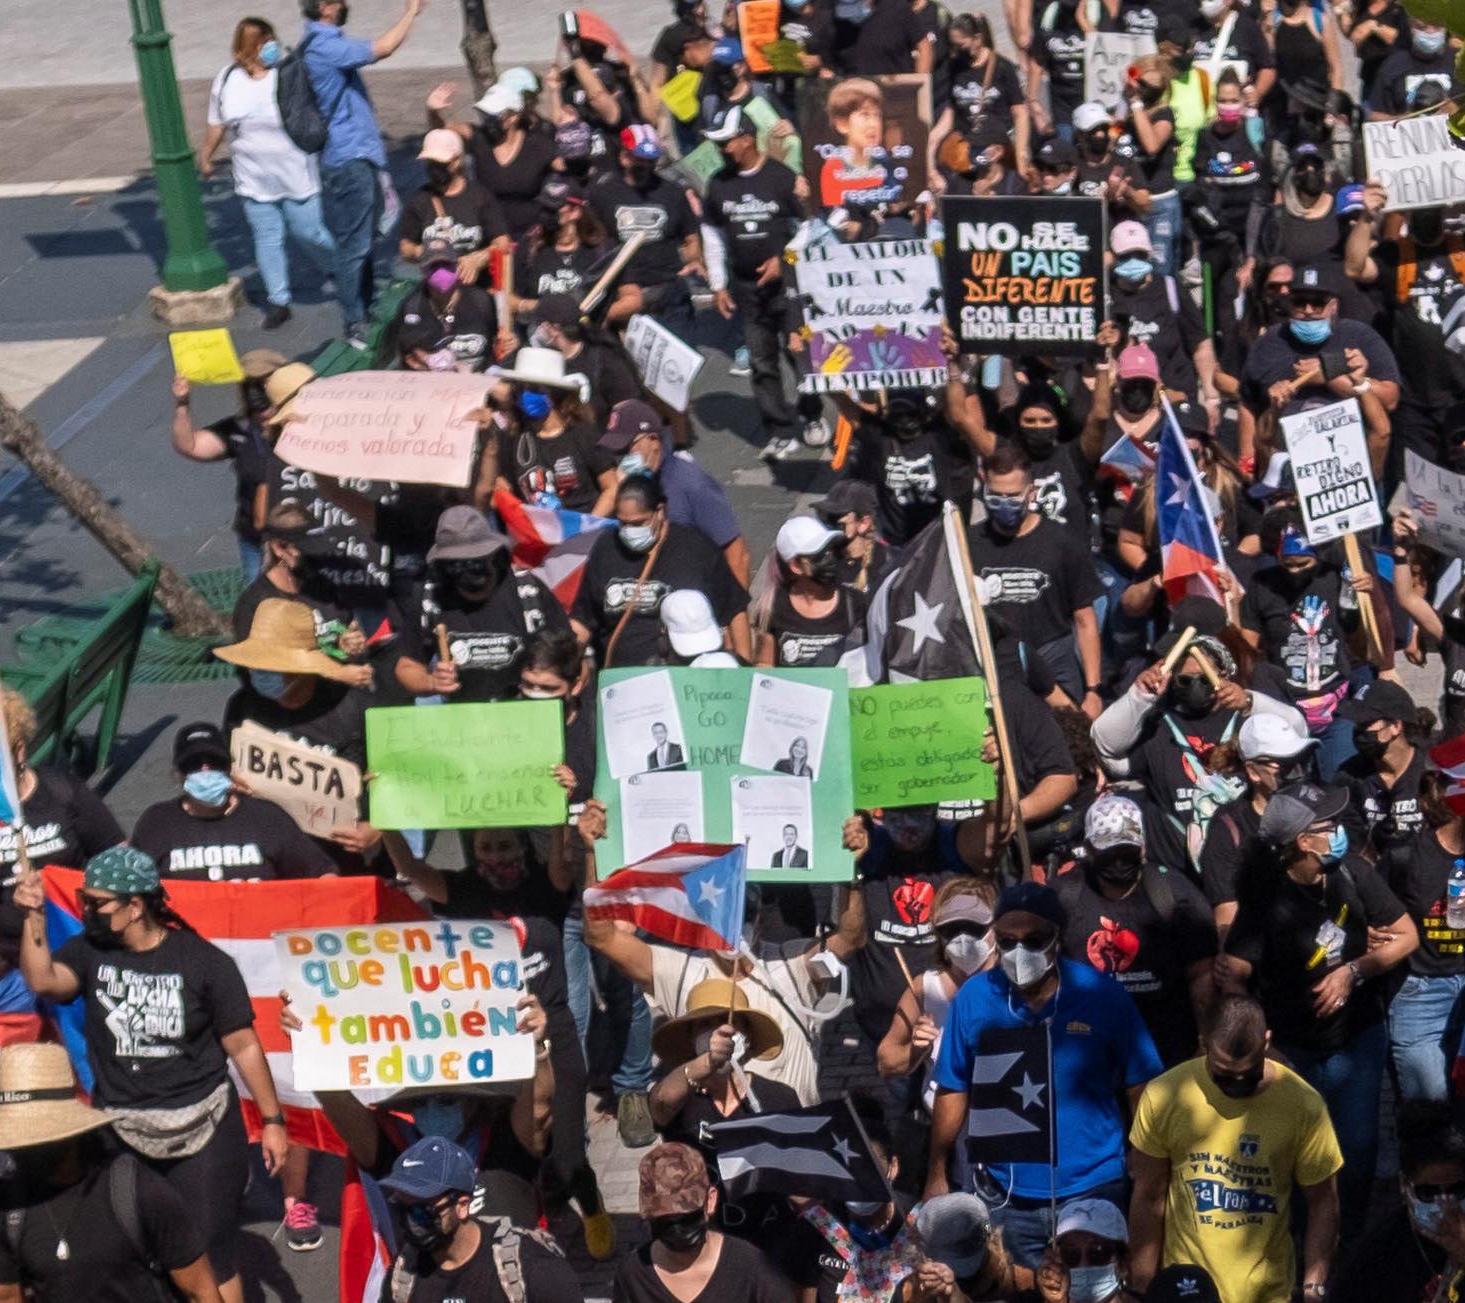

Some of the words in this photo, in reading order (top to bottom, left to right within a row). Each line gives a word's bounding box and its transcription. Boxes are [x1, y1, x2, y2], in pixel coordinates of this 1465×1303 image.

[958, 223, 1020, 250] NO
[1033, 222, 1076, 238] SE
[1022, 236, 1090, 250] HACE
[972, 252, 998, 277] UN
[826, 270, 860, 288] DE
[875, 269, 906, 286] UN
[963, 278, 1095, 304] DIFERENTE
[828, 298, 914, 317] Maestro
[961, 306, 1008, 322] CON
[1019, 306, 1095, 323] GENTE
[961, 322, 1095, 340] INDIFERENTE
[1311, 483, 1371, 517] AHORA
[239, 736, 345, 799] ¡BASTA
[302, 958, 385, 998] que
